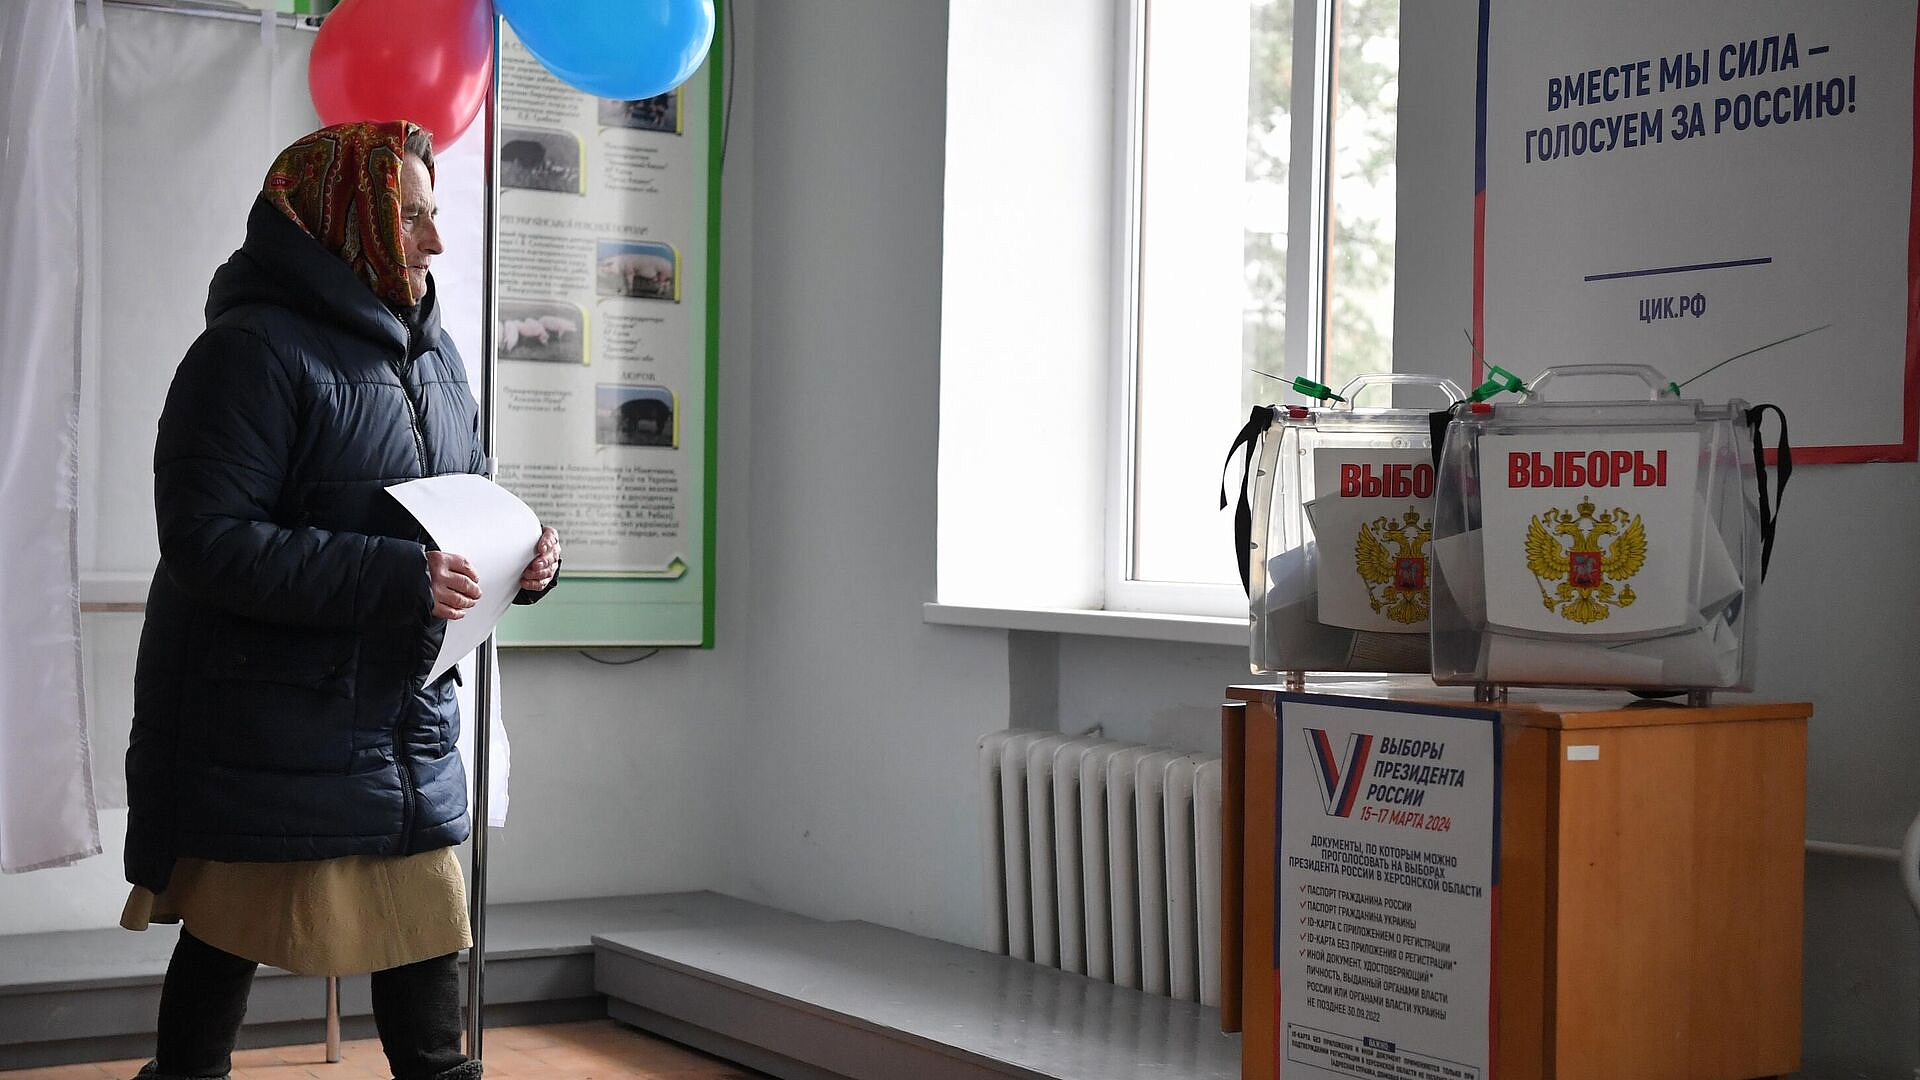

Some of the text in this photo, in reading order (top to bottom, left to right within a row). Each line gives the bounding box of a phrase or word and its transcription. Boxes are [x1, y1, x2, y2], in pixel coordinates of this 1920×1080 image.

[1547, 58, 1651, 112] ВМЕСТЕ
[1659, 49, 1710, 90] МЫ
[1718, 33, 1799, 82] СИЛА
[1525, 75, 1856, 164] ГОЛОСУЕМ ЗА РОССИЮ!
[1639, 293, 1707, 324] ЦИК.РФ
[1340, 463, 1435, 498] ВЫБО
[1508, 449, 1668, 489] ВЫБОРЫ
[1380, 737, 1445, 760] ВЫБОРЫ
[1373, 760, 1465, 788] ПРЕЗИДЕНТА
[1366, 783, 1425, 807] РОССИИ
[1389, 810, 1424, 828] МАРТА
[1425, 815, 1451, 832] 2024
[1311, 835, 1457, 868] ДОКУМЕНТЫ, ПО КОТОРЫМ МОЖНО
[1321, 849, 1445, 879] ПРОГОЛОСОВАТЬ НА ВЫБОРАХ
[1289, 856, 1482, 898] ПРЕЗИДЕНТА РОССИИ В ХЕРСОНСКОЙ ОБЛАСТИ
[1307, 885, 1412, 912] ПАСПОРТ ГРАЖДАНИНА РОССИИ
[1307, 901, 1416, 929] ПАСПОРТ ГРАЖДАНИНА УКРАИНЫ
[1307, 917, 1451, 953] ID-КАРТА С ПРИЛОЖЕНИЕМ О РЕГИСТРАЦИИ
[1307, 933, 1336, 946] ID-КАРТА
[1337, 939, 1350, 950] БЕЗ
[1351, 942, 1397, 959] ПРИЛОЖЕНИЯ
[1398, 950, 1403, 960] О
[1306, 948, 1325, 961] ИНОЙ
[1343, 972, 1382, 990] ВЫДАННЫЙ
[1383, 981, 1420, 998] ОРГАНАМИ
[1306, 981, 1447, 1020] РОССИИ ИЛИ ОРГАНАМИ ВЛАСТИ УКРАИНЫ
[1307, 996, 1380, 1022] НЕ ПОЗДНЕЕ 30.09.2022
